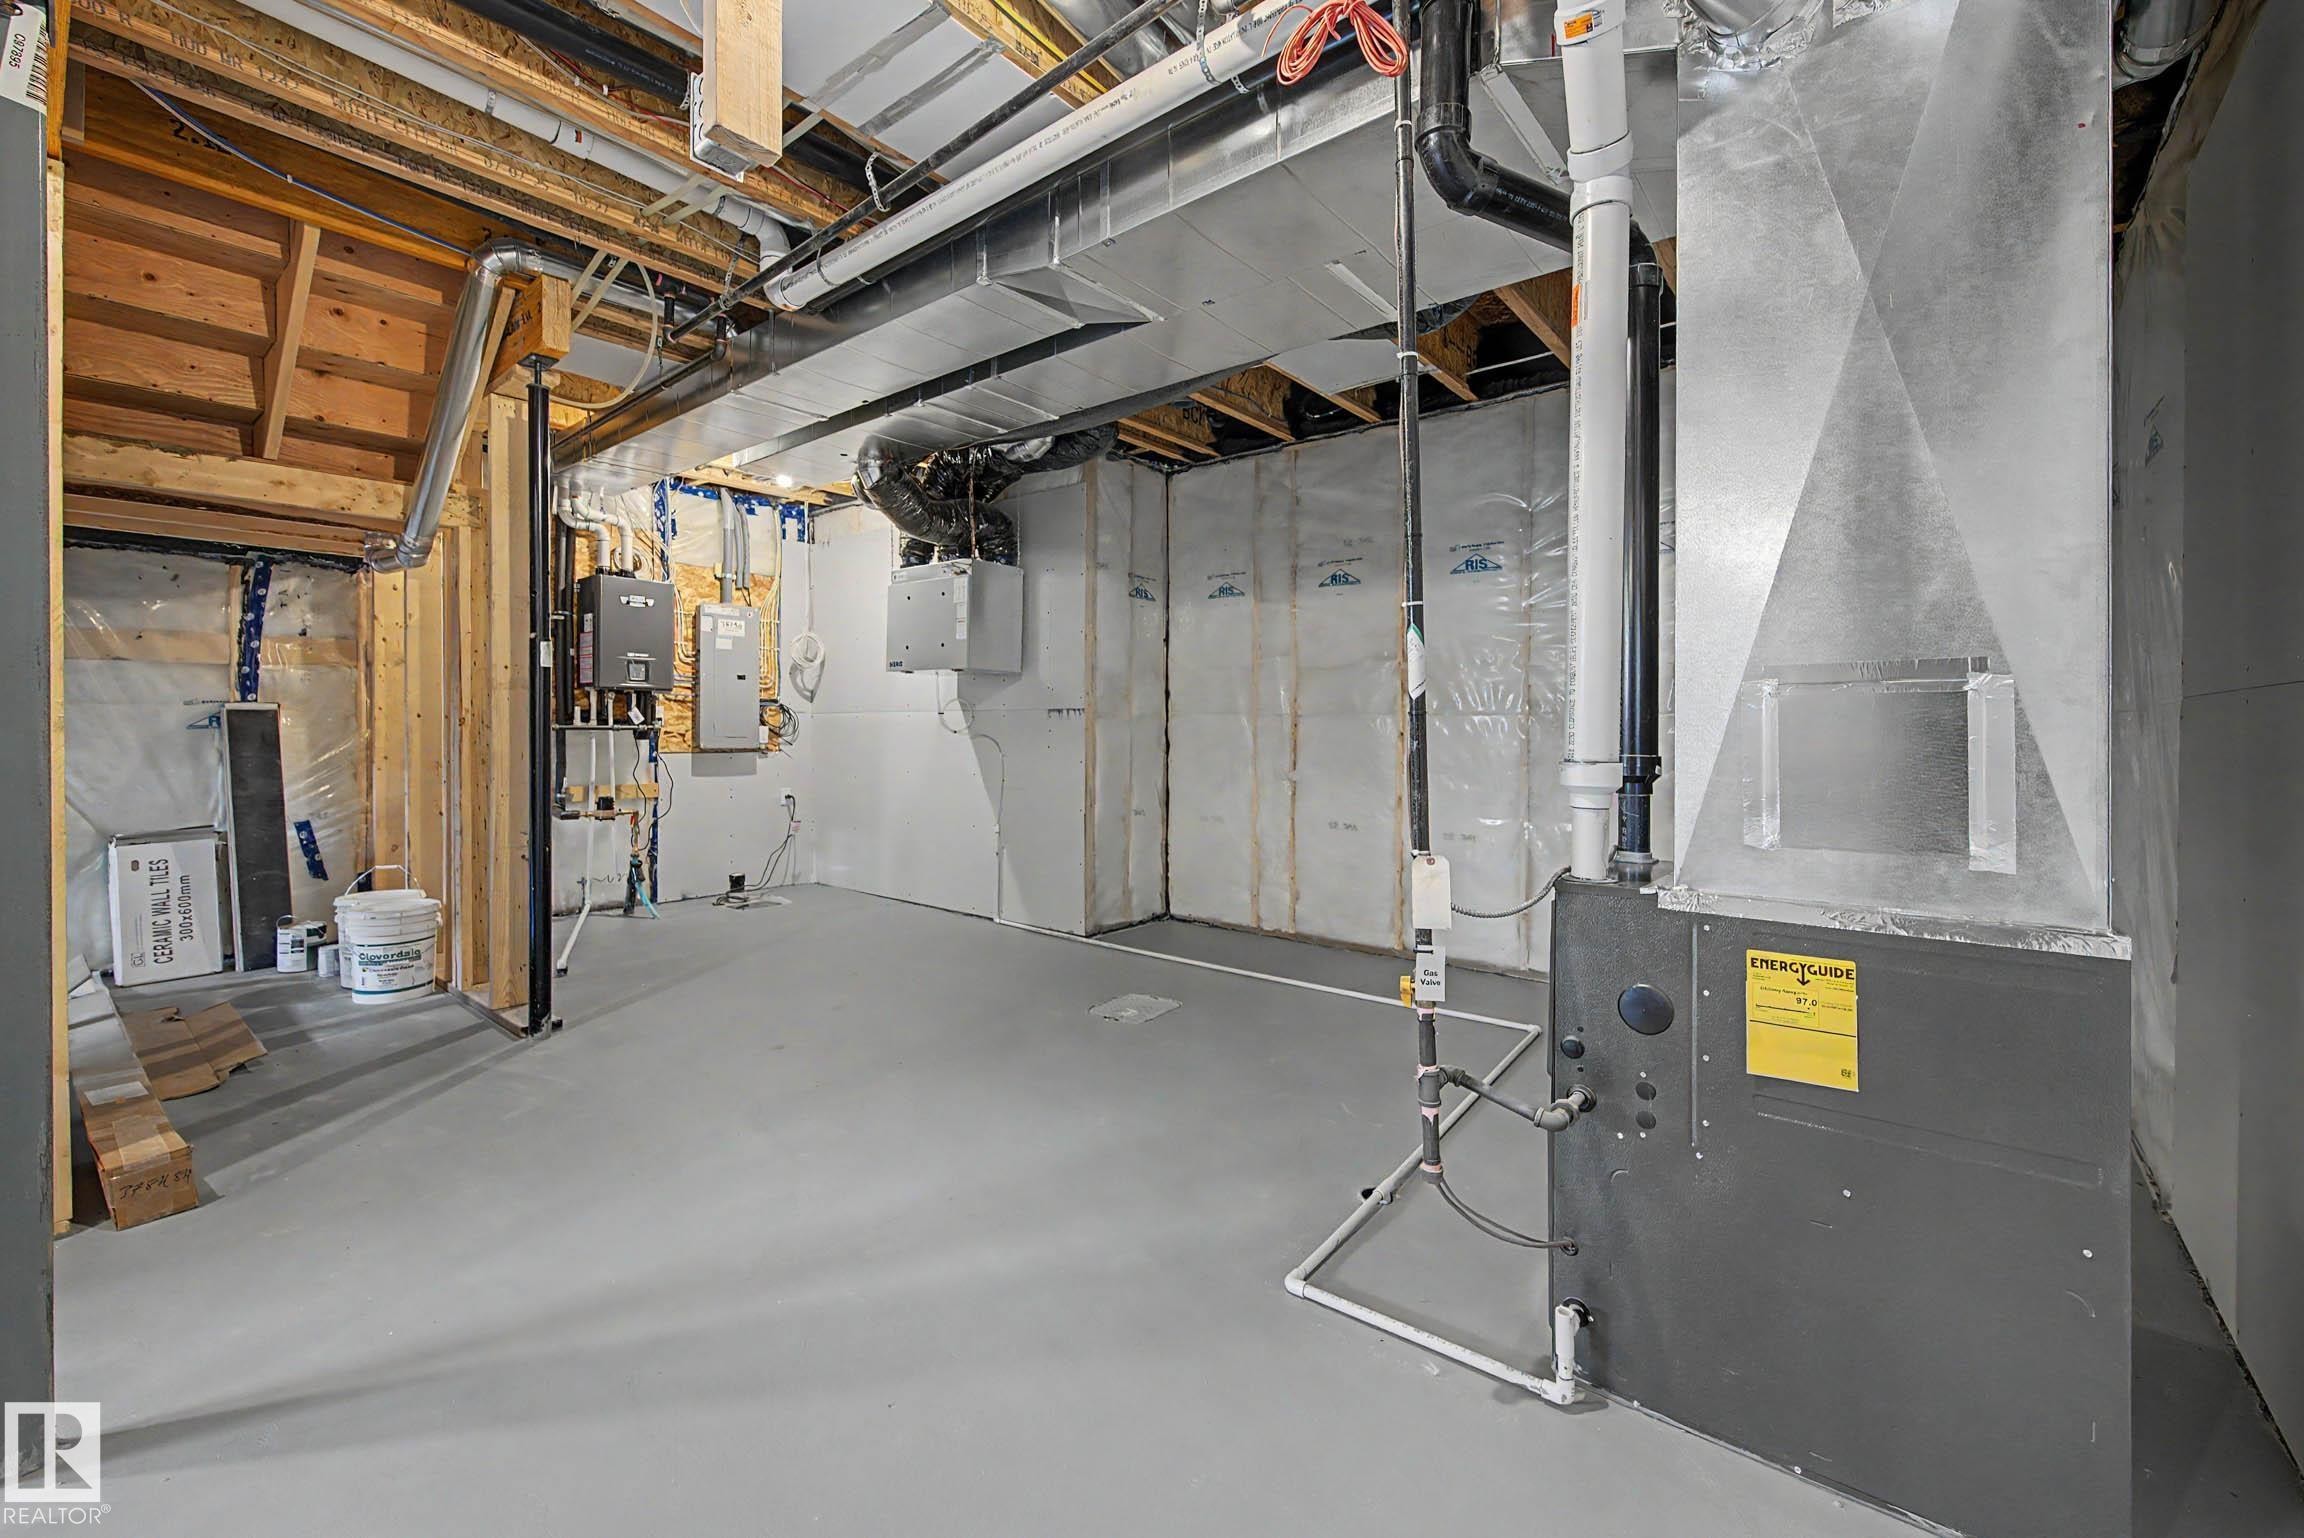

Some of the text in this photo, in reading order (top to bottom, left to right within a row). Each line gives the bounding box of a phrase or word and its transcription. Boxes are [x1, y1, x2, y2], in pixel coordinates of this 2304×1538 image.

[9, 33, 26, 69] C97895
[1465, 559, 1488, 571] RIS
[1330, 573, 1350, 585] RIS
[1135, 587, 1149, 599] RIS
[1218, 585, 1234, 597] RIS
[149, 859, 173, 965] CERAMIC WALL TILES
[177, 874, 193, 942] 300x600mm
[1423, 969, 1438, 977] Gas
[1750, 957, 1855, 981] ENERGYGUIDE
[1420, 978, 1441, 986] Valve
[1796, 997, 1818, 1007] 97.0
